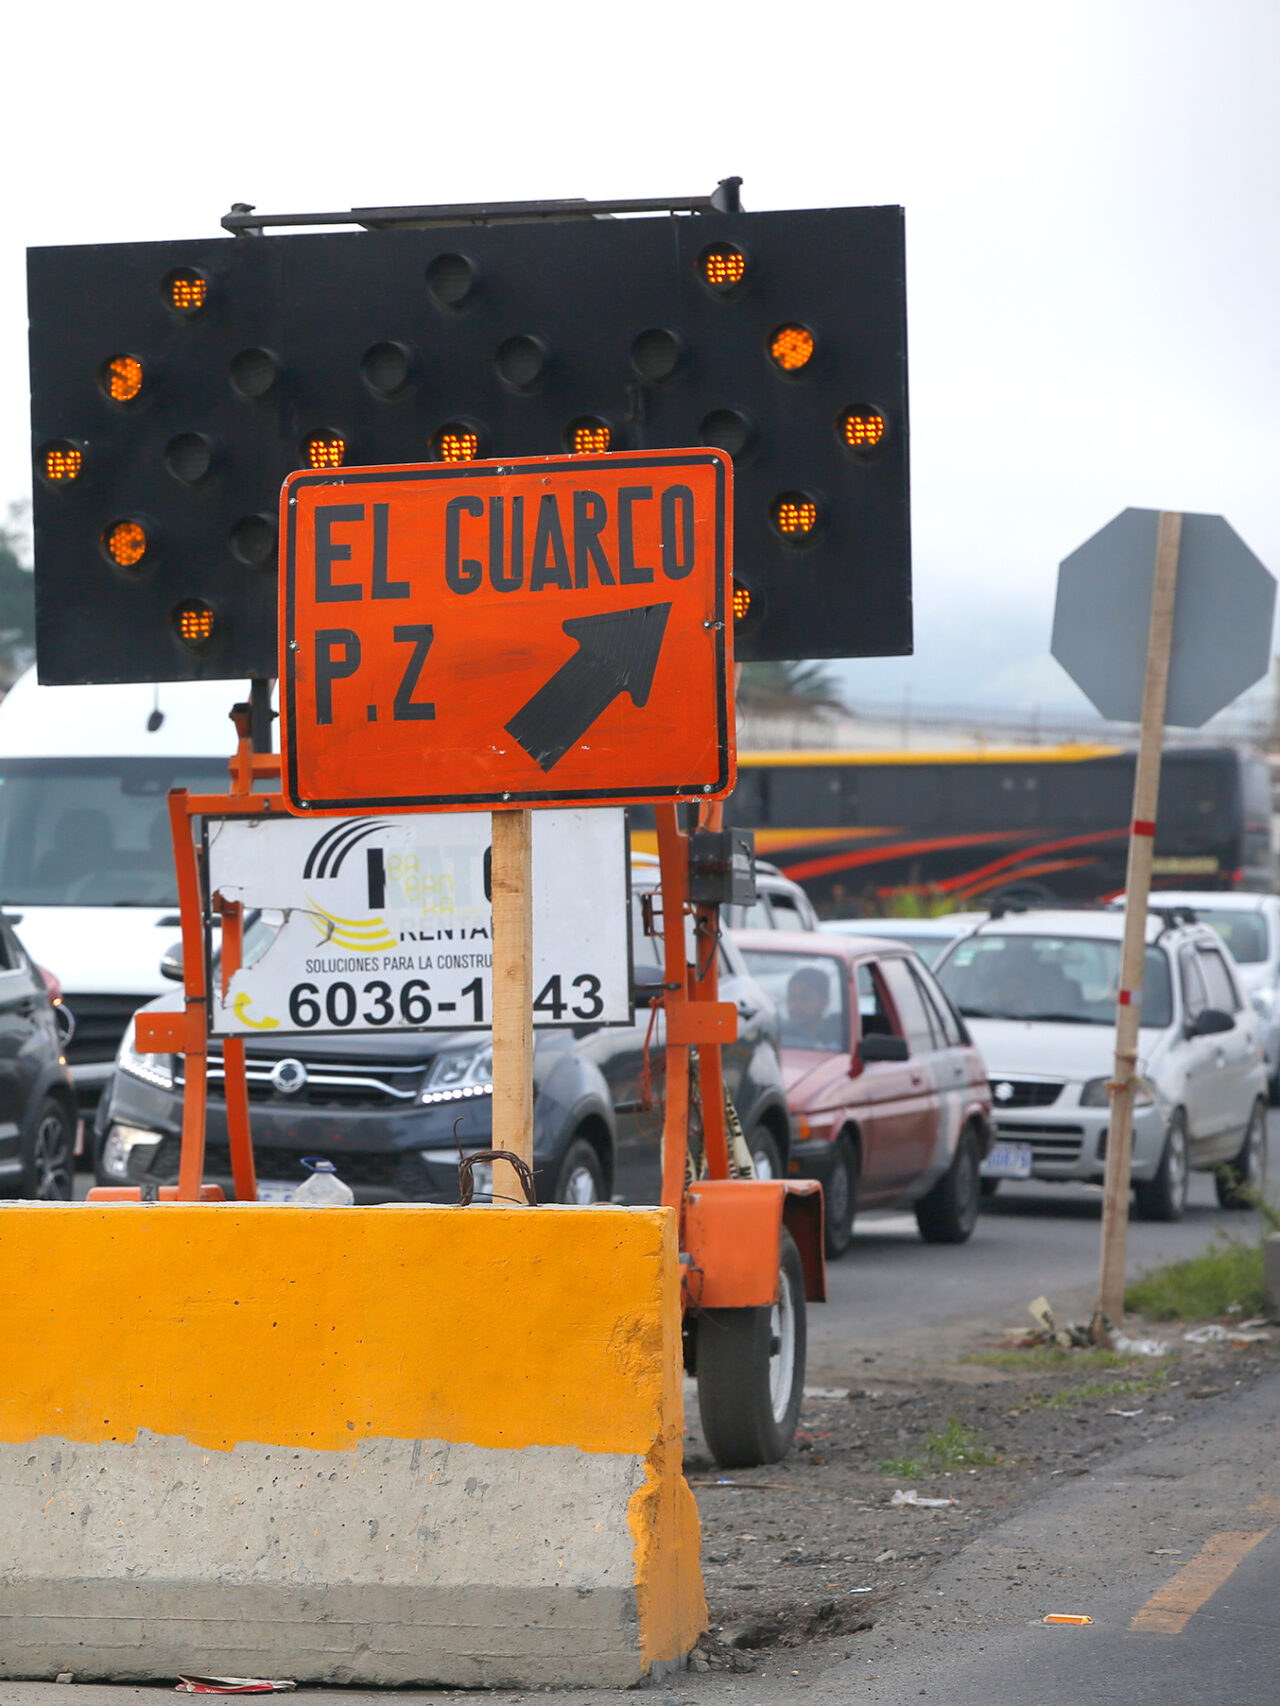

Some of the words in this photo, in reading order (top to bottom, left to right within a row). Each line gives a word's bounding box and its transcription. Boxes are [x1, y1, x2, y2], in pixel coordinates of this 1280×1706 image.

[314, 503, 411, 603] EL
[445, 484, 695, 595] GUARCO
[314, 623, 436, 725] P.Z
[399, 915, 493, 942] RENTA
[305, 956, 380, 974] SOLUCIONES
[383, 955, 415, 971] PARA
[418, 955, 433, 970] LA
[436, 953, 492, 969] CONSTRU
[288, 973, 604, 1028] 6036-143
